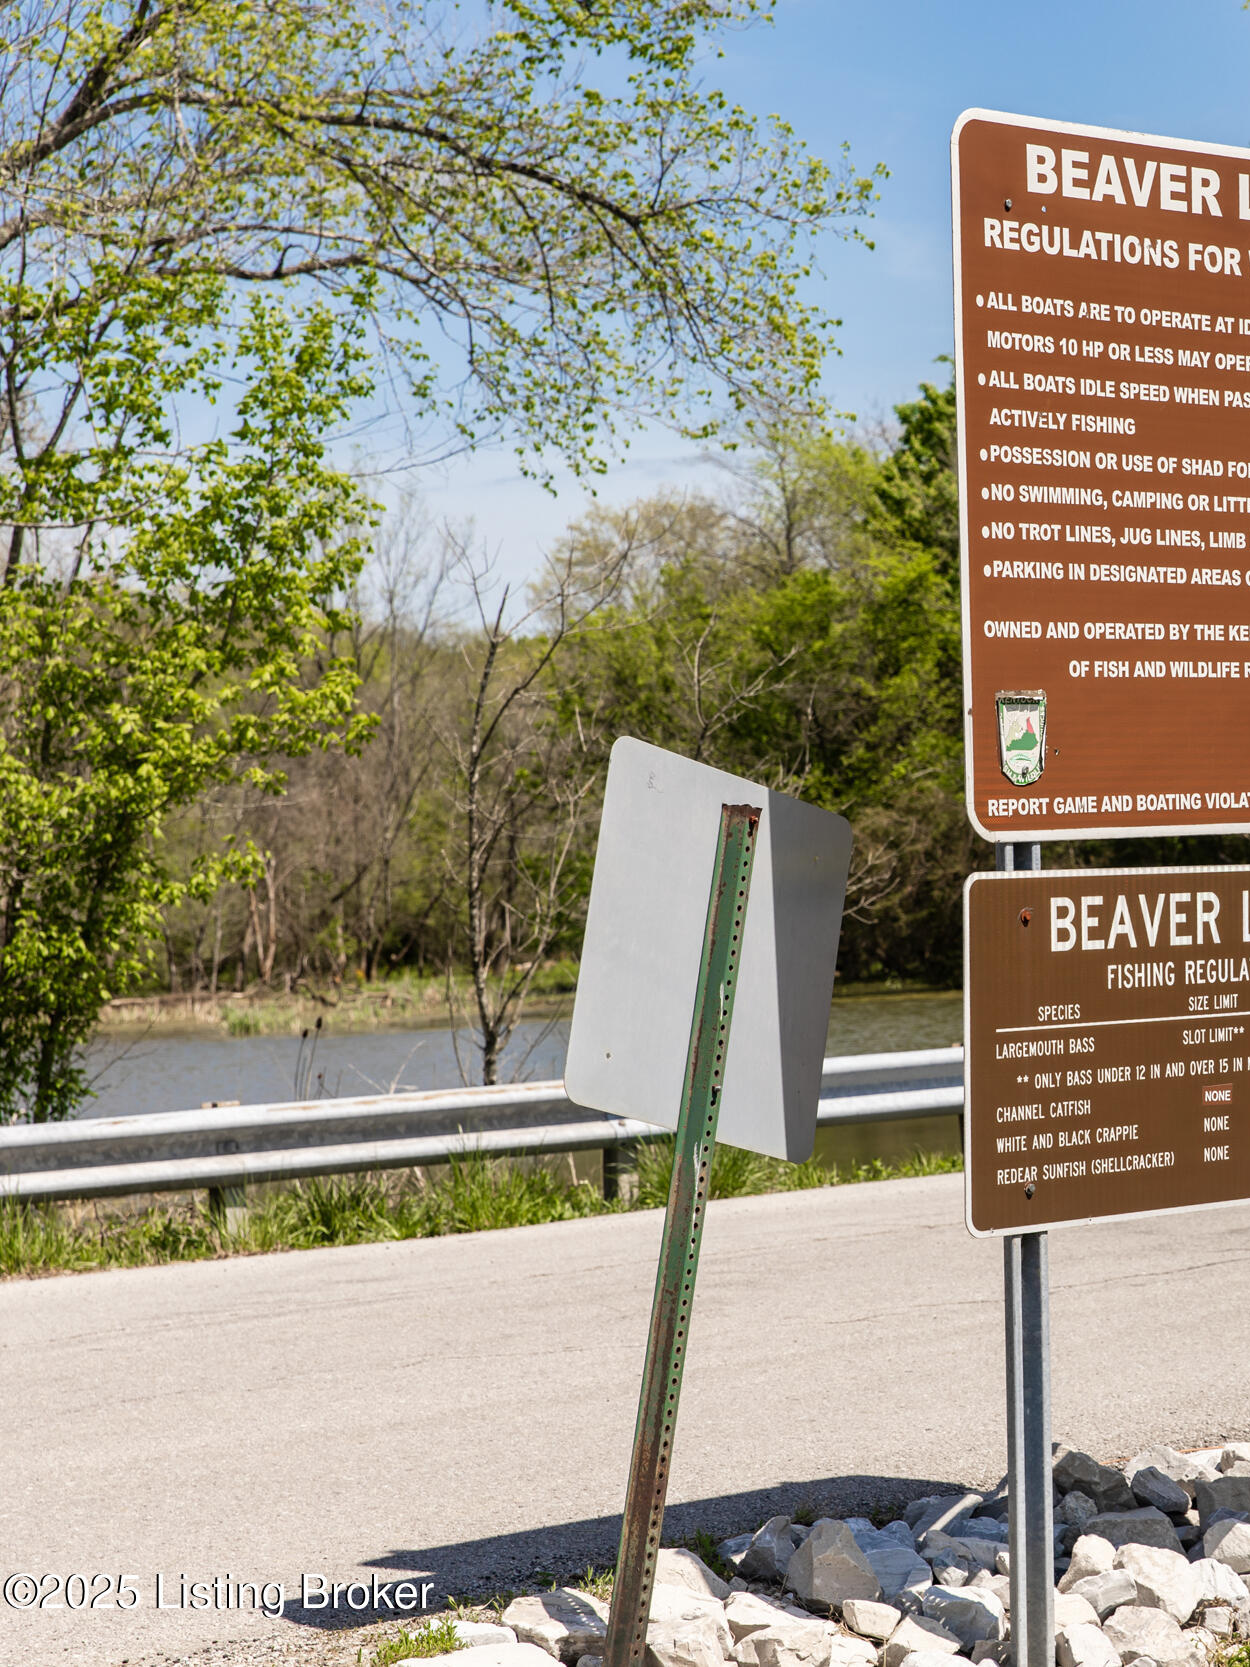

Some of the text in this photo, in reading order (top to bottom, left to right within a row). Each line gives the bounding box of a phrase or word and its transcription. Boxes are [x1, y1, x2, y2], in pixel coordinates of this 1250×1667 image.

[1026, 144, 1223, 217] BEAVER
[984, 218, 1179, 268] REGULATIONS
[1188, 243, 1242, 276] FOR
[987, 292, 1017, 311] ALL
[1022, 295, 1074, 317] BOATS
[1078, 302, 1110, 321] ARE
[1114, 306, 1136, 324] TO
[1140, 308, 1211, 331] OPERATE
[1215, 316, 1235, 333] AT
[987, 330, 1055, 353] MOTORS
[1059, 338, 1078, 356] 10
[1082, 340, 1104, 358] HP
[1108, 343, 1131, 361] OR
[1135, 345, 1174, 365] LESS
[1178, 349, 1211, 368] MAY
[989, 370, 1019, 389] ALL
[1024, 373, 1076, 394] BOATS
[1080, 379, 1115, 398] IDLE
[1120, 382, 1170, 402] SPEED
[1173, 386, 1219, 406] WHEN
[989, 408, 1135, 435] ACTIVELY FISHING
[990, 445, 1090, 468] POSSESSION
[1095, 452, 1118, 470] OR
[1122, 454, 1153, 472] USE
[1157, 456, 1177, 474] OF
[1182, 458, 1223, 476] SHAD
[991, 483, 1014, 502] NO
[1019, 485, 1107, 510] SWIMMING,
[1112, 490, 1183, 510] CAMPING
[1188, 494, 1210, 511] OR
[991, 522, 1015, 539] NO
[1019, 523, 1061, 541] TROT
[1066, 525, 1116, 547] LINES,
[1120, 528, 1152, 545] JUG
[1156, 529, 1205, 551] LINES,
[1209, 531, 1246, 549] LIMB
[993, 560, 1064, 580] PARKING
[1069, 563, 1085, 580] IN
[1090, 564, 1187, 584] DESIGNATED
[1191, 568, 1241, 586] AREAS
[984, 620, 1042, 638] OWNED
[1046, 622, 1080, 639] AND
[1084, 622, 1165, 640] OPERATED
[1169, 624, 1190, 640] BY
[1194, 624, 1224, 641] THE
[1069, 660, 1090, 677] OF
[1094, 661, 1129, 678] FISH
[1133, 661, 1166, 677] AND
[1169, 661, 1240, 678] WILDLIFE
[988, 798, 1049, 817] REPORT
[1053, 796, 1097, 814] GAME
[1101, 795, 1133, 812] AND
[1136, 793, 1201, 811] BOATING
[1050, 892, 1221, 952] BEAVER
[1108, 961, 1175, 989] FISHING
[1038, 1004, 1080, 1021] SPECIES
[1188, 994, 1238, 1011] SIZE LIMIT
[996, 1037, 1095, 1059] LARGEMOUTH BASS
[1183, 1029, 1206, 1045] SLOT
[1035, 1072, 1062, 1089] ONLY
[1067, 1069, 1092, 1086] BASS
[1097, 1066, 1131, 1083] UNDER
[1136, 1065, 1146, 1080] 12
[1150, 1064, 1160, 1079] IN
[1165, 1062, 1185, 1078] AND
[1190, 1059, 1214, 1076] OVER
[1219, 1058, 1229, 1073] 15
[1233, 1057, 1243, 1072] IN
[1205, 1090, 1231, 1102] NONE
[997, 1100, 1091, 1123] CHANNEL CATFISH
[1204, 1116, 1229, 1132] NONE
[996, 1124, 1138, 1153] WHITE AND BLACK CRAPPIE
[1204, 1145, 1229, 1162] NONE
[997, 1151, 1174, 1185] REDEAR SUNFISH (SHELLCRACKER)
